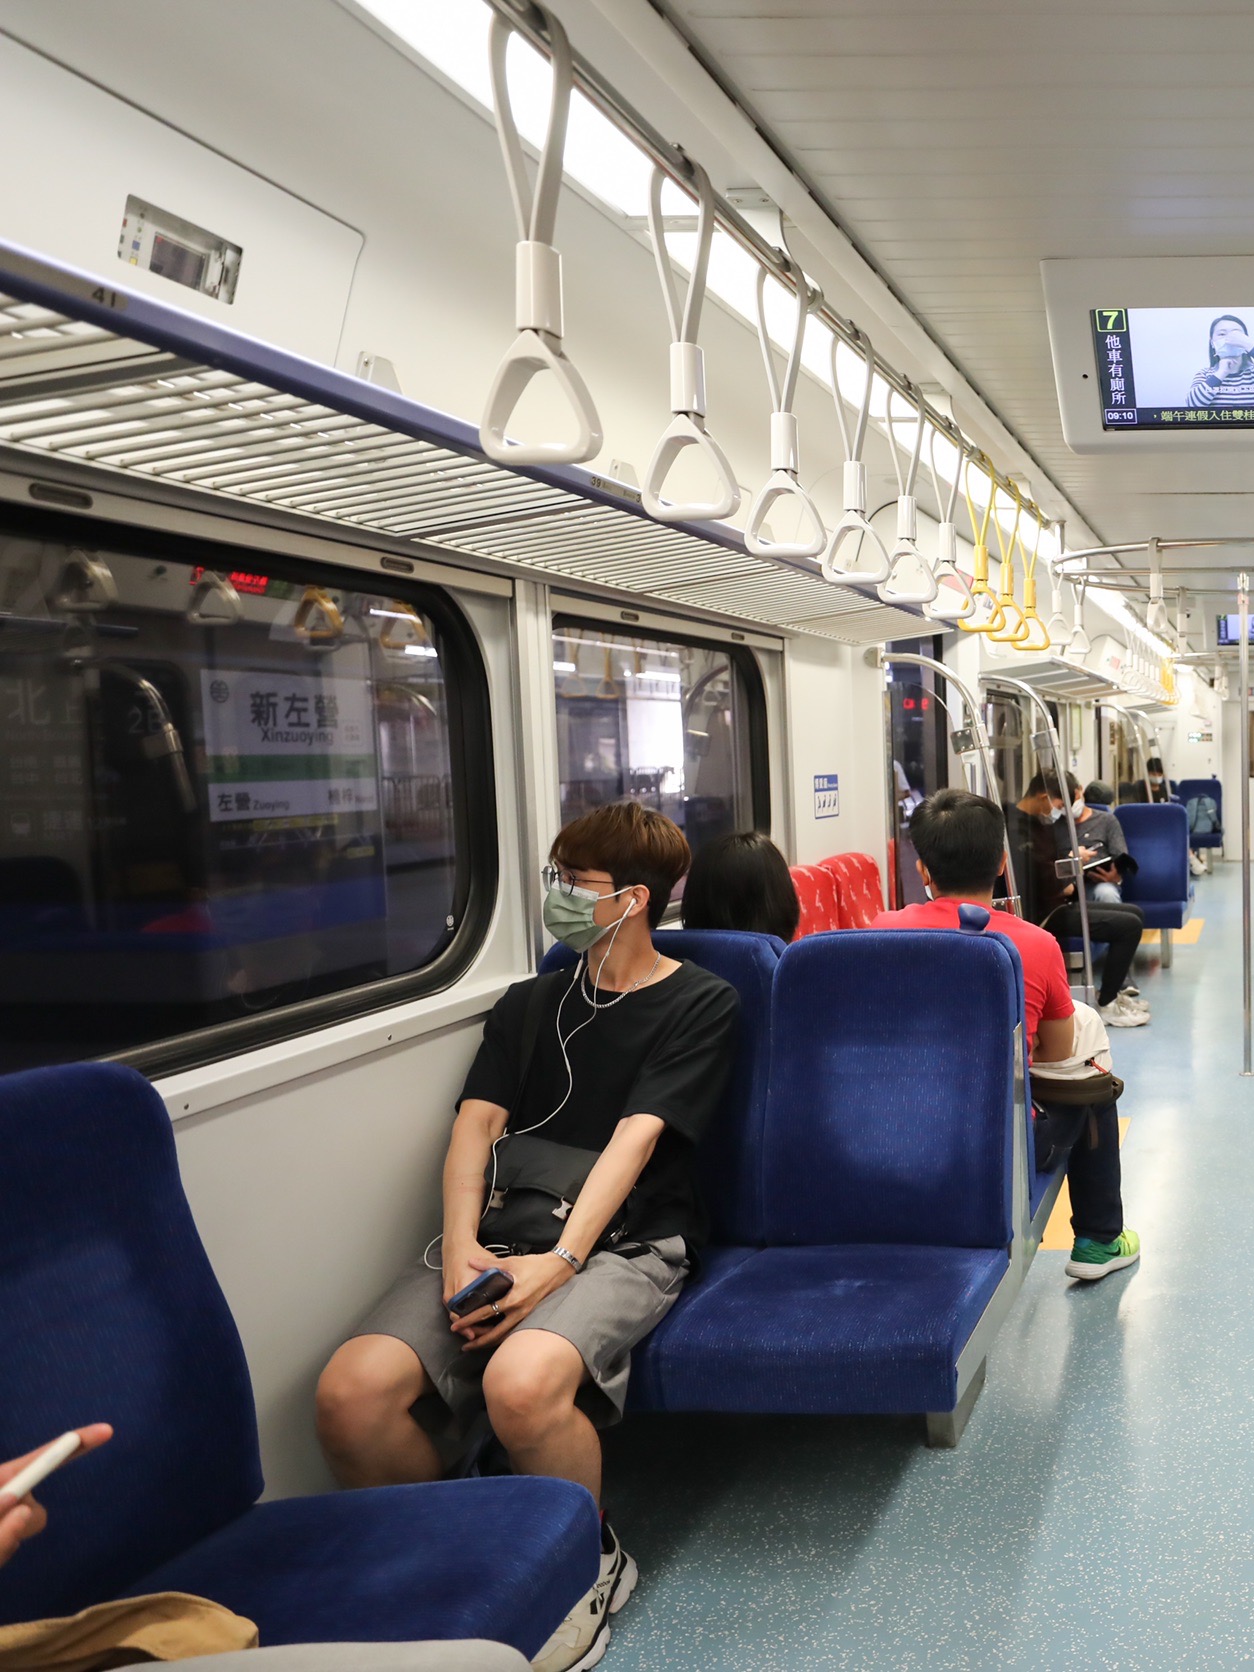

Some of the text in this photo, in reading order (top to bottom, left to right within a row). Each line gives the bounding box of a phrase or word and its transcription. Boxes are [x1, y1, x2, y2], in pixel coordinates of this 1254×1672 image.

[92, 286, 117, 308] 41
[1102, 311, 1119, 330] 7
[1105, 334, 1126, 405] 他車有廁所
[1107, 412, 1133, 420] 09:10
[591, 476, 602, 488] 39
[249, 690, 339, 729] 新左營
[260, 727, 334, 746] Xinzuoying
[253, 798, 290, 813] Zuoying
